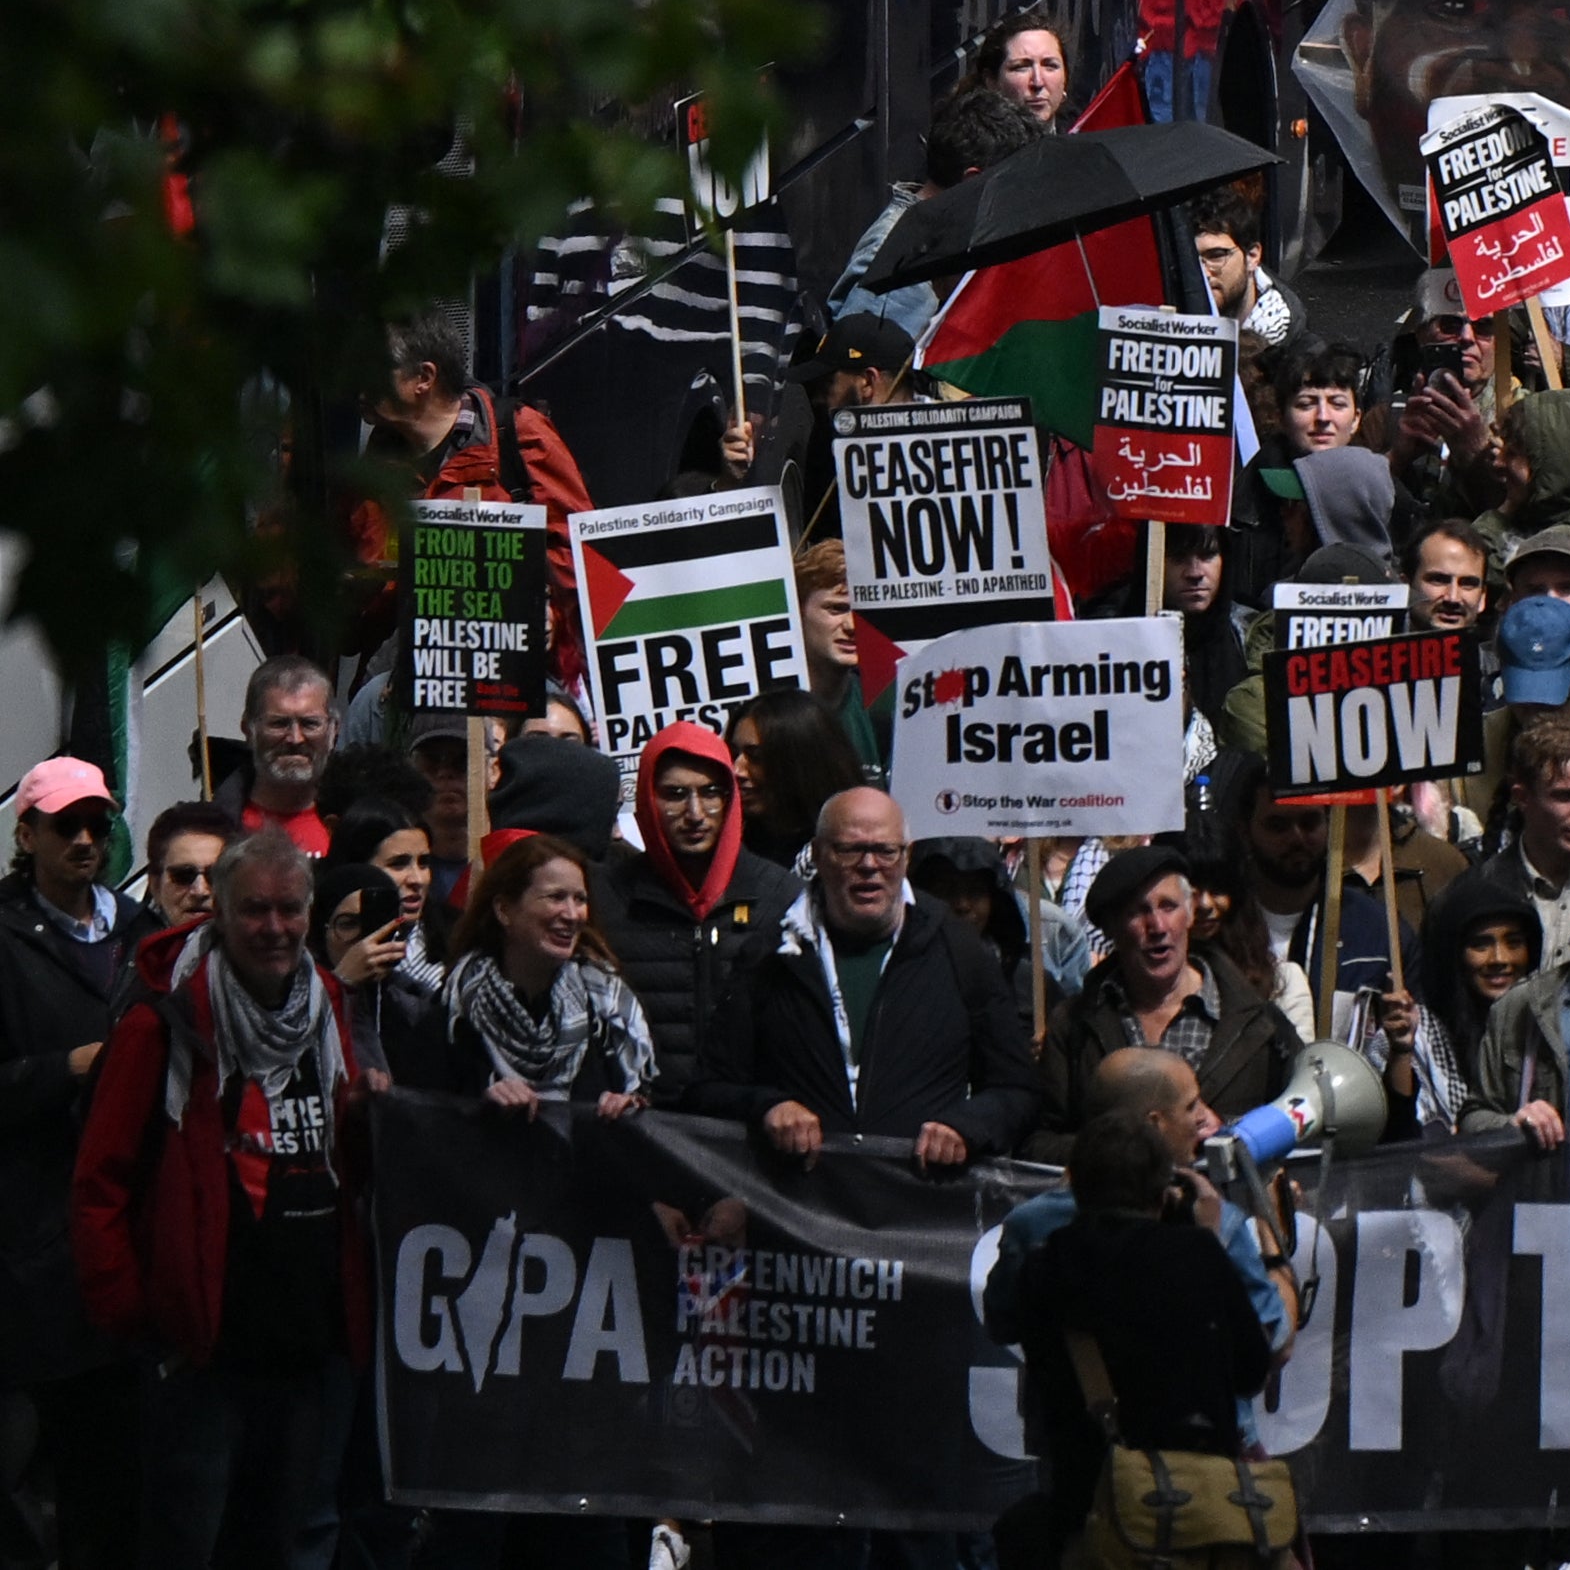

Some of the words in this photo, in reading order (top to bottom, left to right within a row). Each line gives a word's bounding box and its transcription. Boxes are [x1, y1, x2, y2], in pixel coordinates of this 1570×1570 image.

[1474, 212, 1545, 260] الحرية
[1477, 235, 1565, 299] لفلسطين
[1118, 314, 1171, 334] Socialist
[1172, 320, 1218, 336] Worker
[1108, 338, 1223, 379] FREEDOM
[912, 408, 967, 426] SOLIDARITY
[969, 404, 1022, 422] CAMPAIGN
[1101, 387, 1227, 429] PALESTINE
[844, 433, 1033, 500] CEASEFIRE
[1118, 436, 1201, 471] الحرية
[1106, 471, 1213, 501] لفلسطين
[418, 506, 475, 523] Socialist
[476, 509, 523, 525] Worker
[579, 515, 639, 535] Palestine
[642, 507, 705, 527] Solidarity
[708, 496, 775, 518] Campaign
[414, 528, 475, 558] FROM
[483, 532, 524, 560] THE
[868, 492, 1025, 580] NOW!
[414, 558, 476, 588] RIVER
[484, 562, 512, 590] TO
[853, 585, 881, 602] FREE
[883, 581, 945, 602] PALESTINE
[955, 578, 980, 596] END
[983, 574, 1047, 594] APARTHEID
[414, 589, 455, 616] THE
[463, 591, 502, 619] SEA
[414, 618, 528, 652] PALESTINE
[414, 648, 467, 678] WILL
[473, 651, 501, 680] BE
[596, 617, 800, 716] FREE
[997, 653, 1171, 702] Arming
[1286, 635, 1462, 697] CEASEFIRE
[414, 679, 467, 709] FREE
[946, 710, 1110, 764] Israel
[1287, 675, 1461, 785] NOW
[962, 794, 997, 810] Stop
[1000, 794, 1023, 808] the
[1027, 794, 1056, 808] War
[1060, 793, 1125, 808] coalition
[677, 1245, 904, 1302] GREENWICH
[676, 1298, 876, 1350] PALESTINE
[673, 1343, 816, 1395] ACTION
